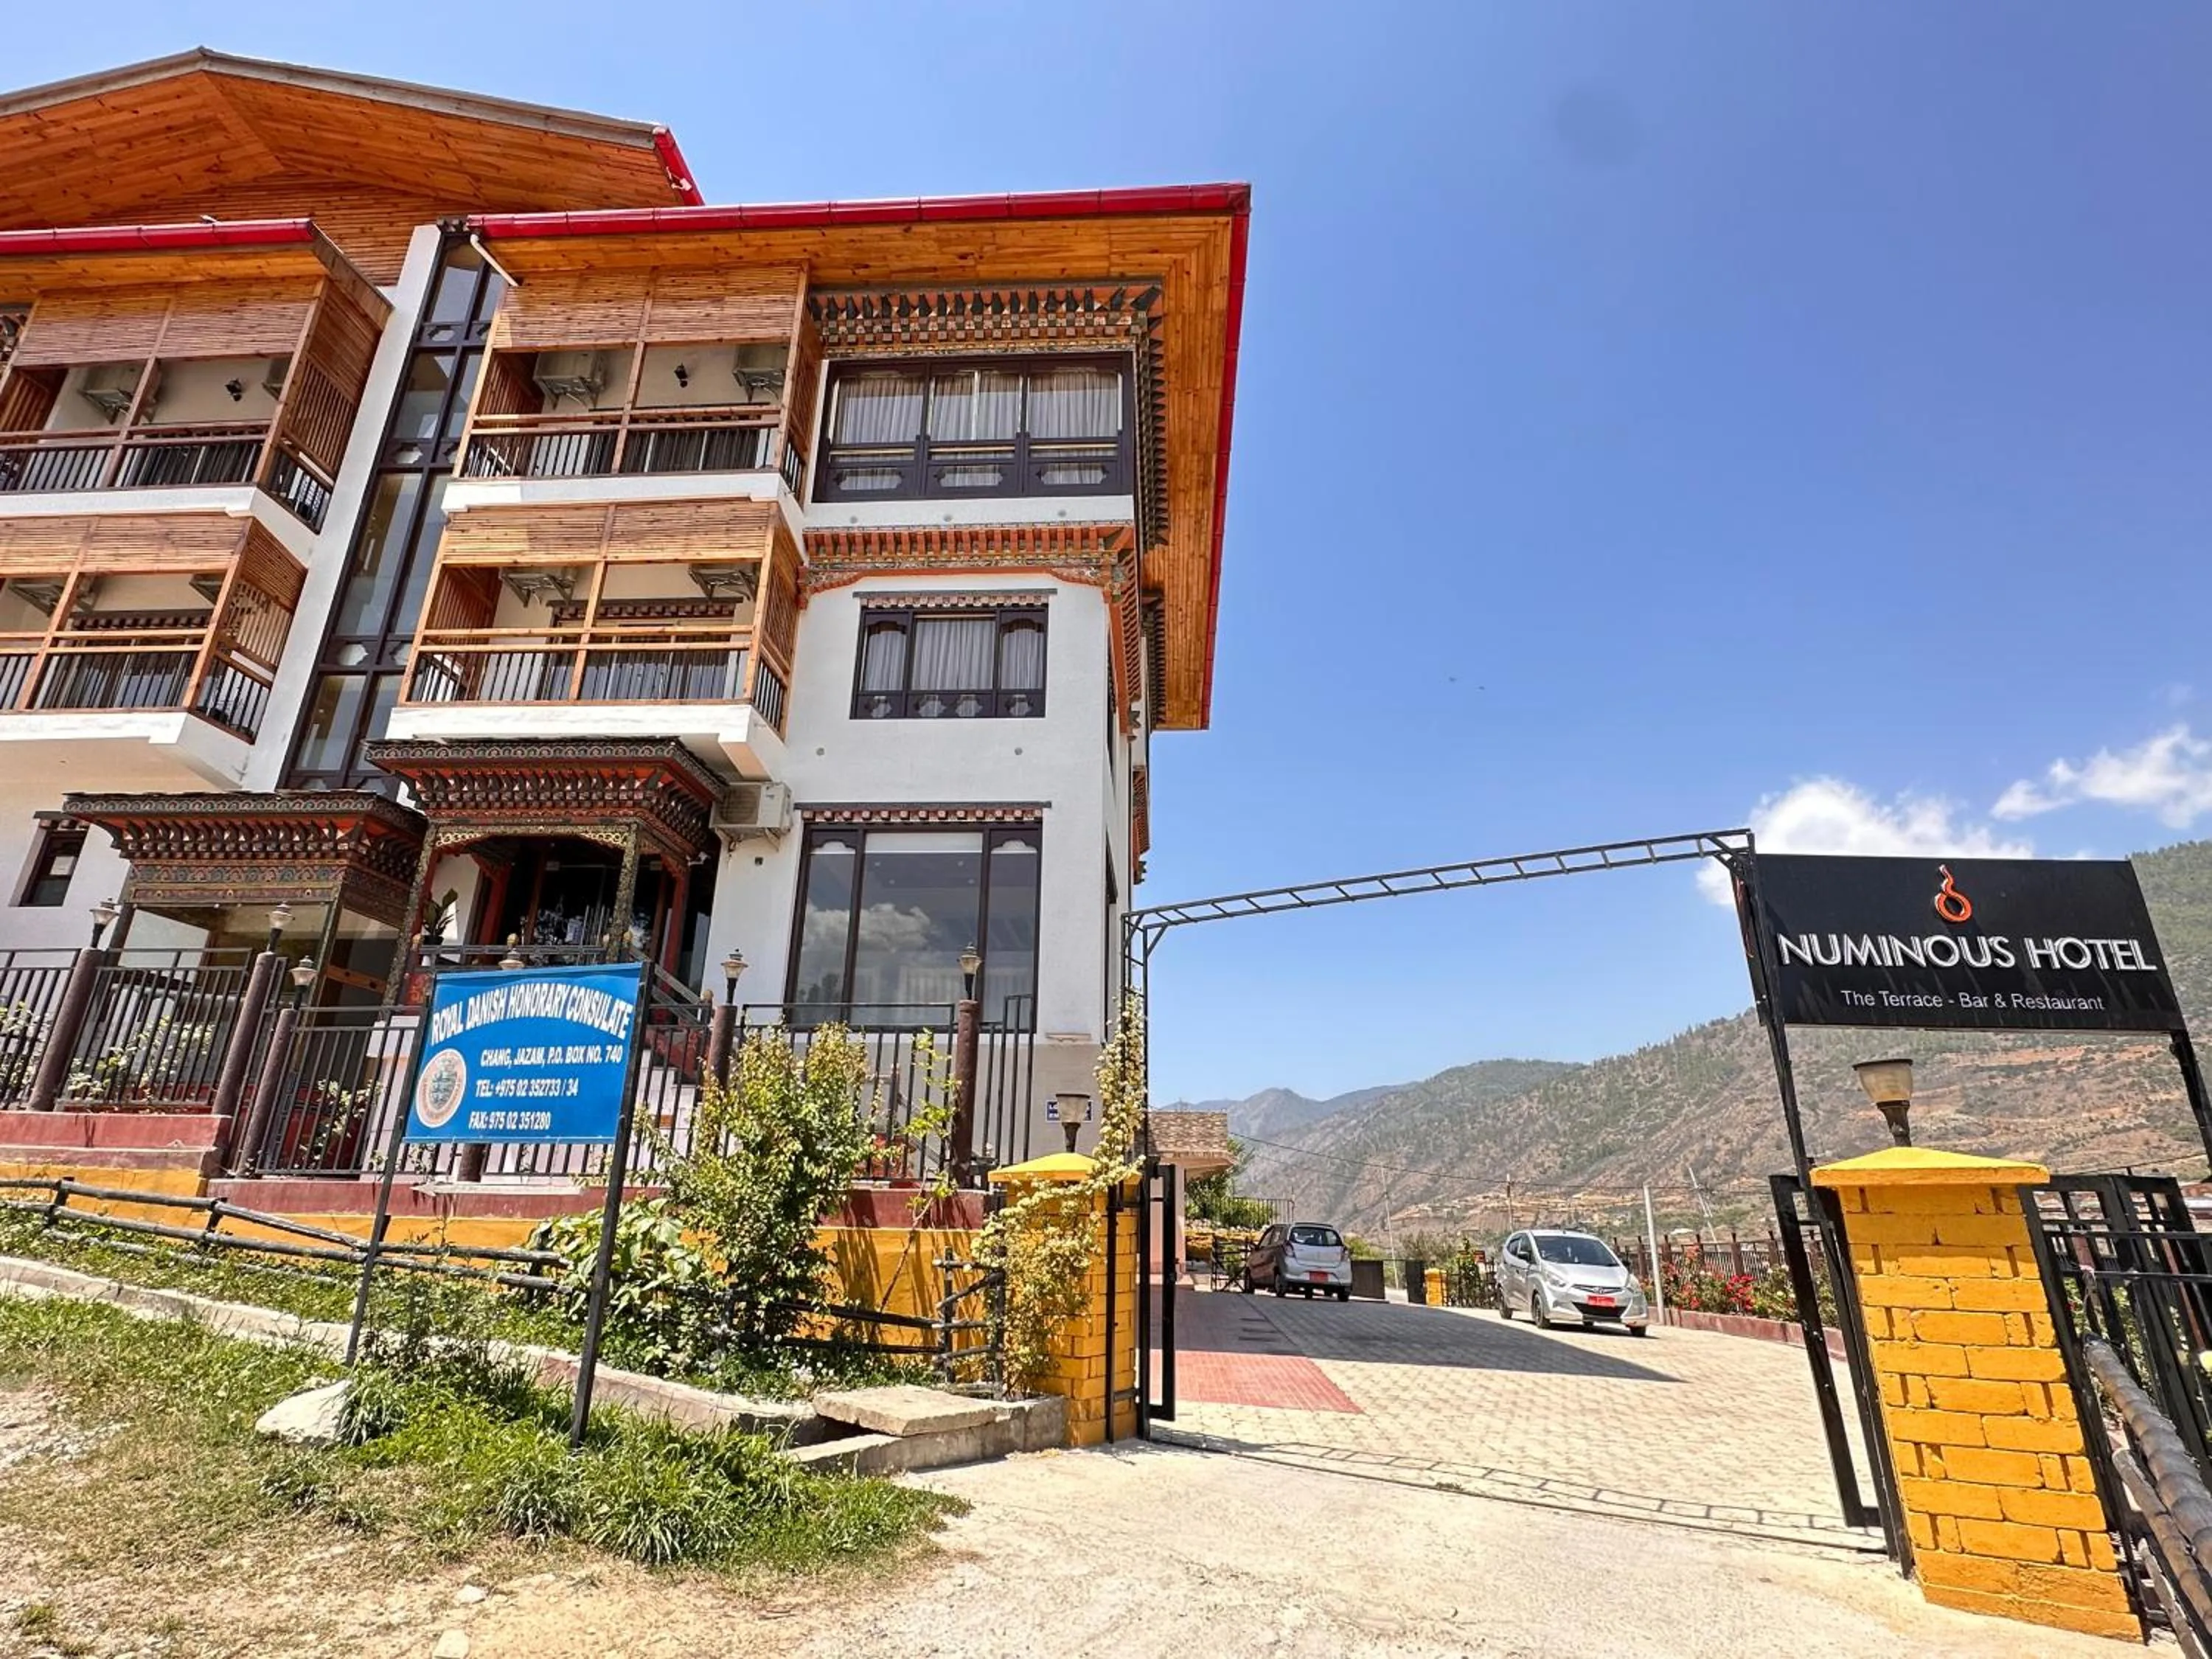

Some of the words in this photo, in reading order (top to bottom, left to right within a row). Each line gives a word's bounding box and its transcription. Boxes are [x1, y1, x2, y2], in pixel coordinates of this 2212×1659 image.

[1777, 933, 2015, 968] NUMINOUS
[2024, 936, 2157, 970] HOTEL
[1840, 990, 1876, 1006] The
[1878, 990, 1943, 1007] Terrace
[1958, 992, 1989, 1008] Bar
[1994, 993, 2006, 1008] &
[2011, 993, 2104, 1009] Restaurant
[431, 1001, 464, 1046] ROYAL
[465, 988, 508, 1030] DANISH
[506, 983, 569, 1019] HONORARY
[566, 985, 633, 1040] CONSULATE
[481, 1048, 512, 1068] CHANG,
[514, 1047, 545, 1068] JAZAM,
[565, 1046, 586, 1063] BOX
[585, 1046, 602, 1063] NO.
[605, 1045, 623, 1063] 740
[476, 1079, 494, 1097] TEL:
[495, 1079, 516, 1097] +975
[516, 1079, 529, 1097] 02
[529, 1078, 561, 1097] 352733
[566, 1077, 579, 1096] 34
[469, 1111, 487, 1129] FAX:
[488, 1111, 506, 1130] 975
[506, 1111, 518, 1130] 02
[518, 1111, 552, 1130] 351280
